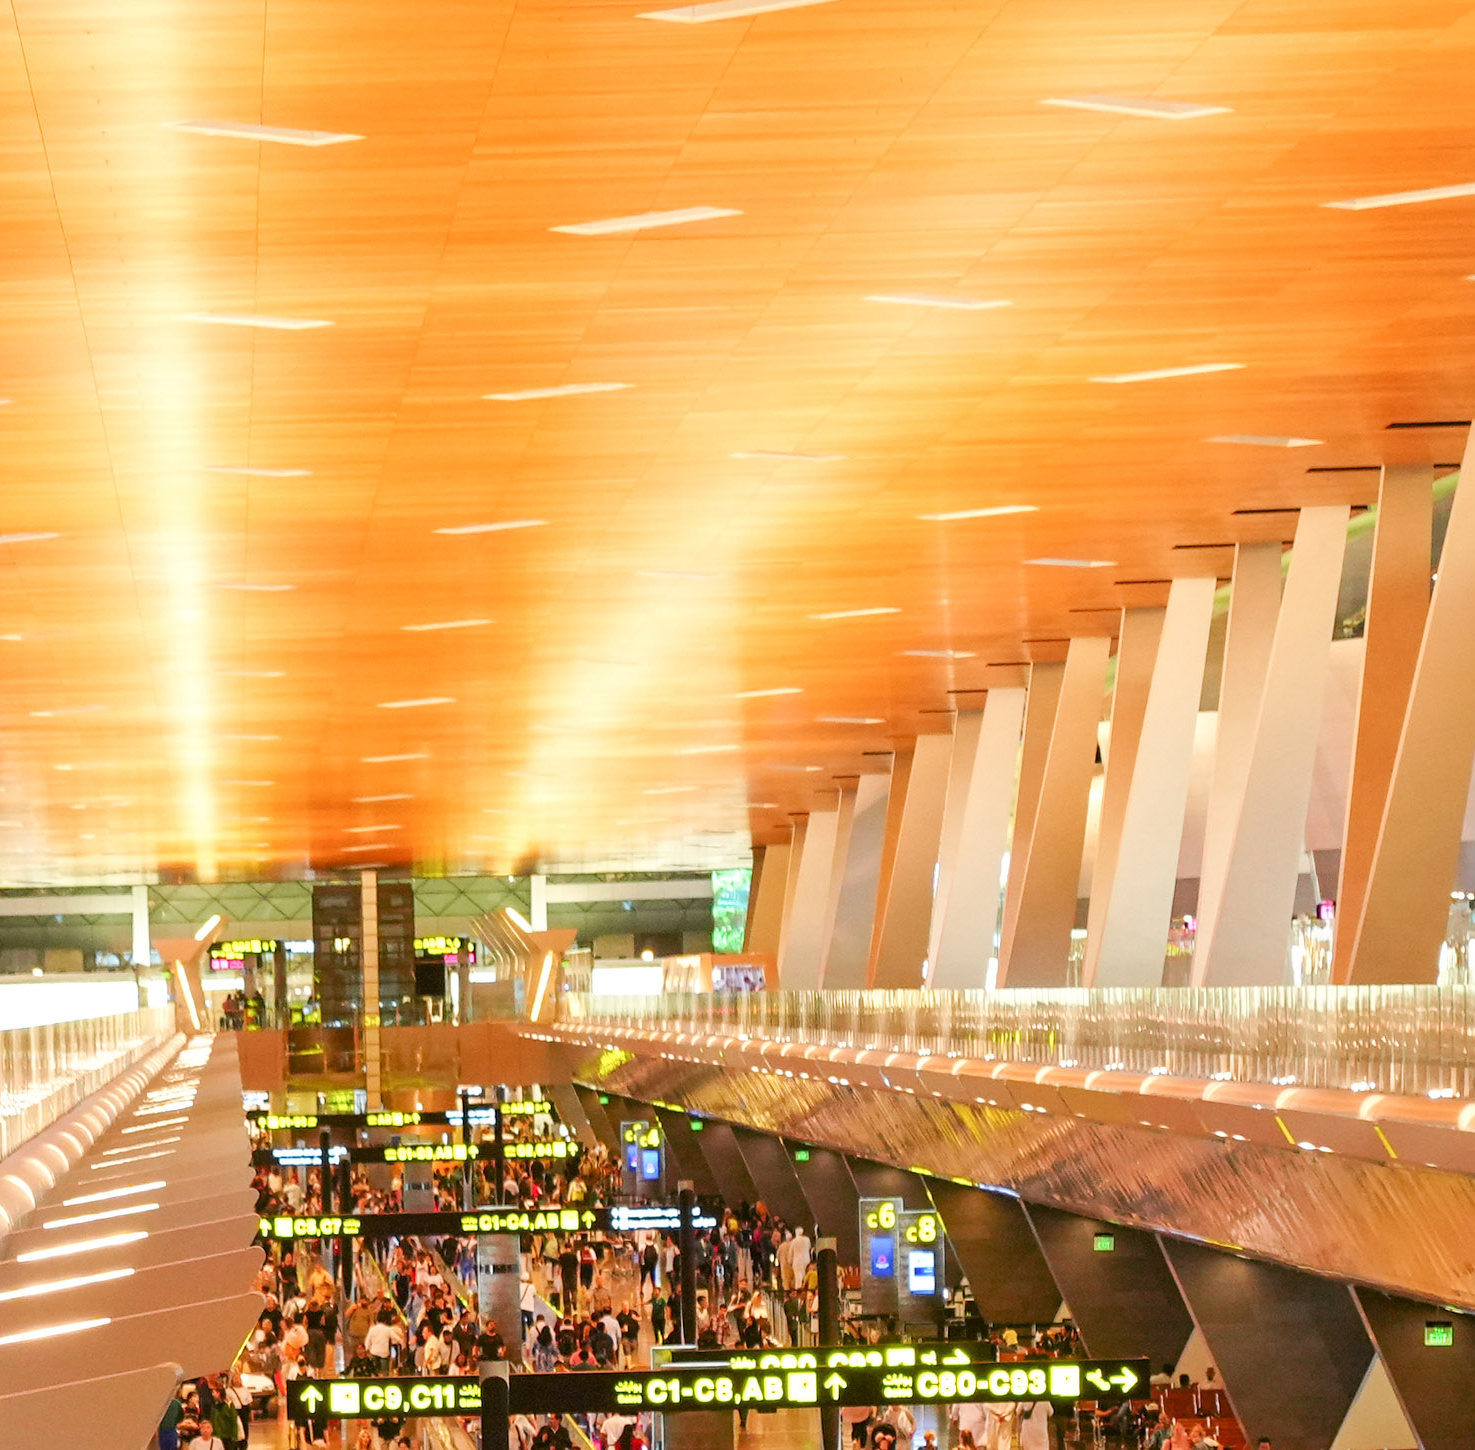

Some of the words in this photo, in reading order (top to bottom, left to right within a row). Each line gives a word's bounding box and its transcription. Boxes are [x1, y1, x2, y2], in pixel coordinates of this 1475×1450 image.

[646, 1376, 784, 1405] C1-C8,AB
[916, 1368, 1047, 1398] C80-C93
[363, 1384, 455, 1413] C9,C11
